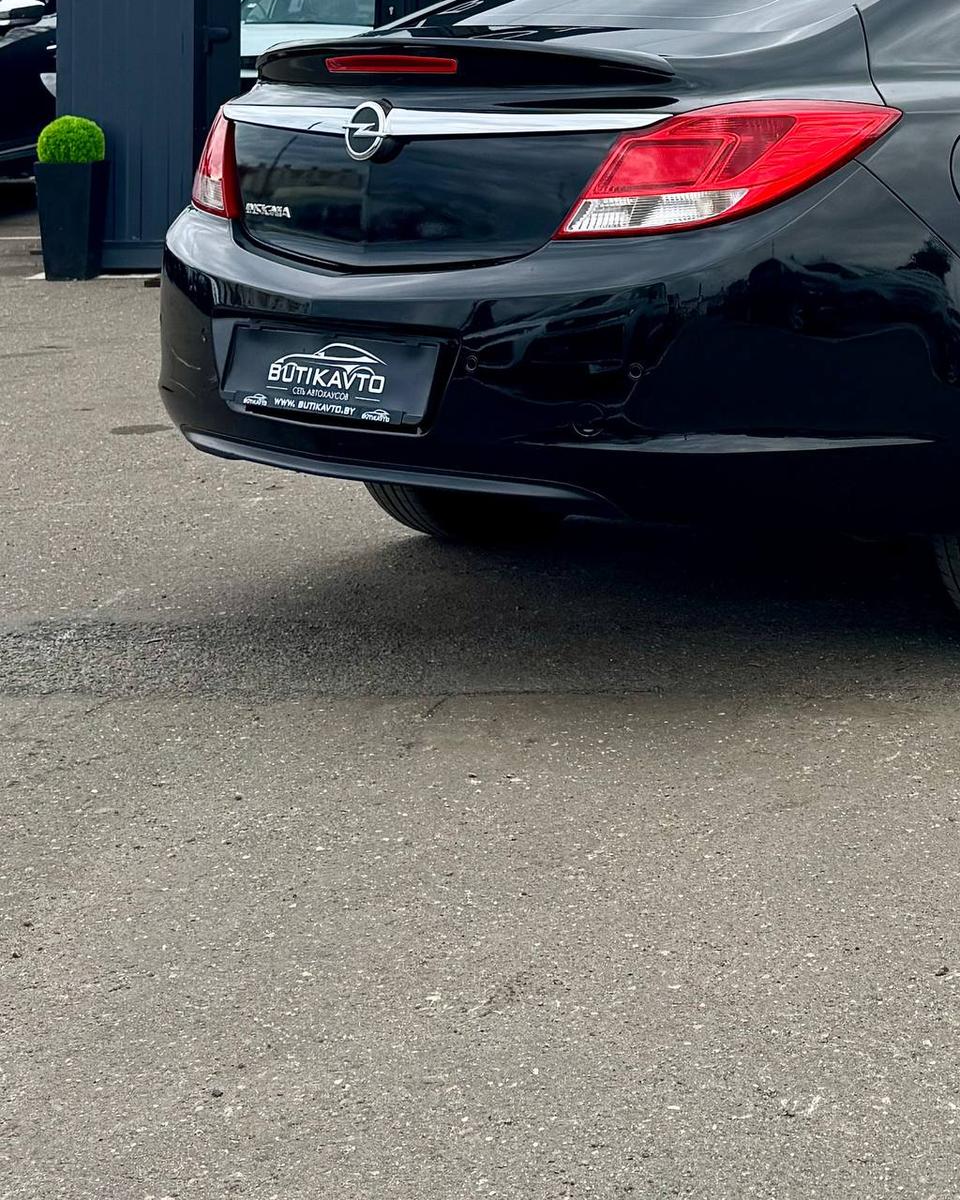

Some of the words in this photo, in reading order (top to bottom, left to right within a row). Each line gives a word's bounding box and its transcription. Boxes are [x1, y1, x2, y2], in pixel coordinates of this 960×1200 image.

[267, 363, 386, 394] BUTIKAVTO
[292, 386, 306, 397] СЕТЬ
[306, 388, 350, 401] АВТОХАУСОВ
[274, 397, 296, 408] WWW.
[297, 402, 357, 416] BUTIKAVTO.BY
